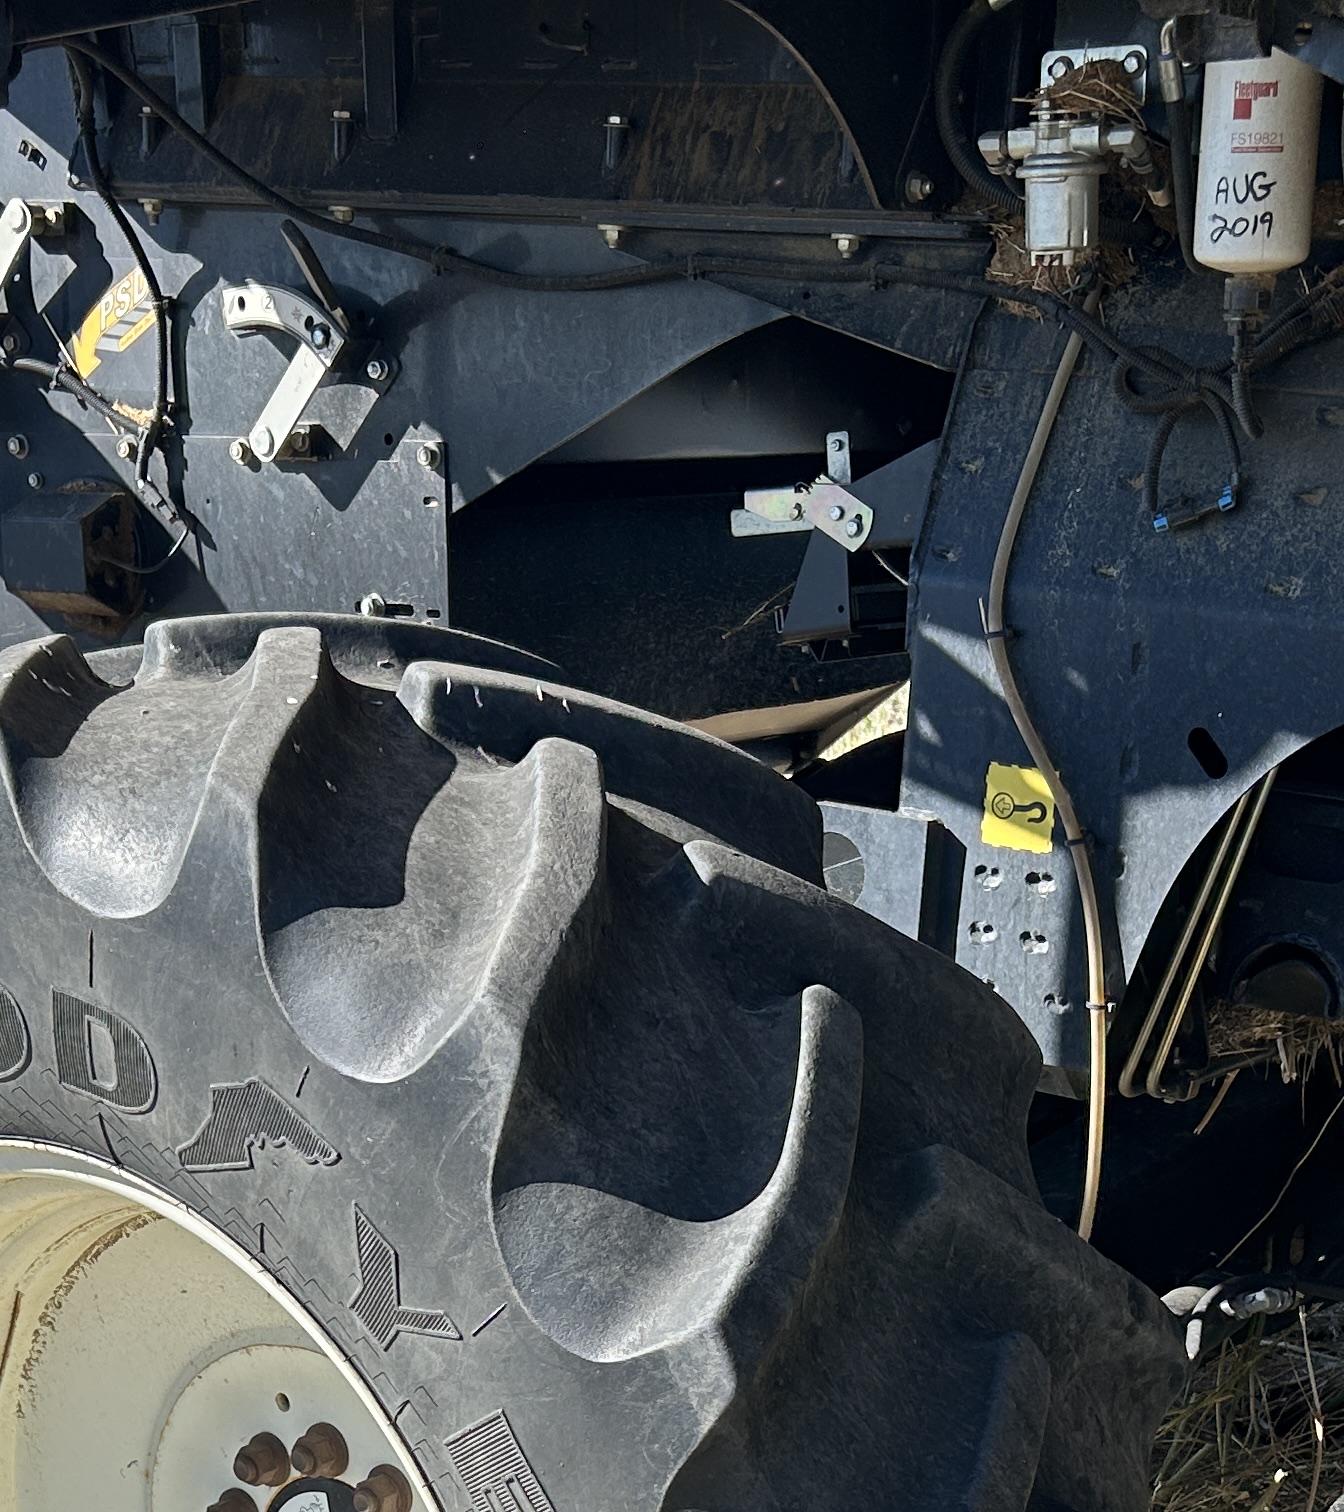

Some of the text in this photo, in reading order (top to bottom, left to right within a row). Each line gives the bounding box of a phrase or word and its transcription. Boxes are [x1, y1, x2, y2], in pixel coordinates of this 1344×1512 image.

[1231, 132, 1283, 146] FS19821
[1215, 171, 1277, 205] AUG
[1210, 211, 1273, 243] 2019
